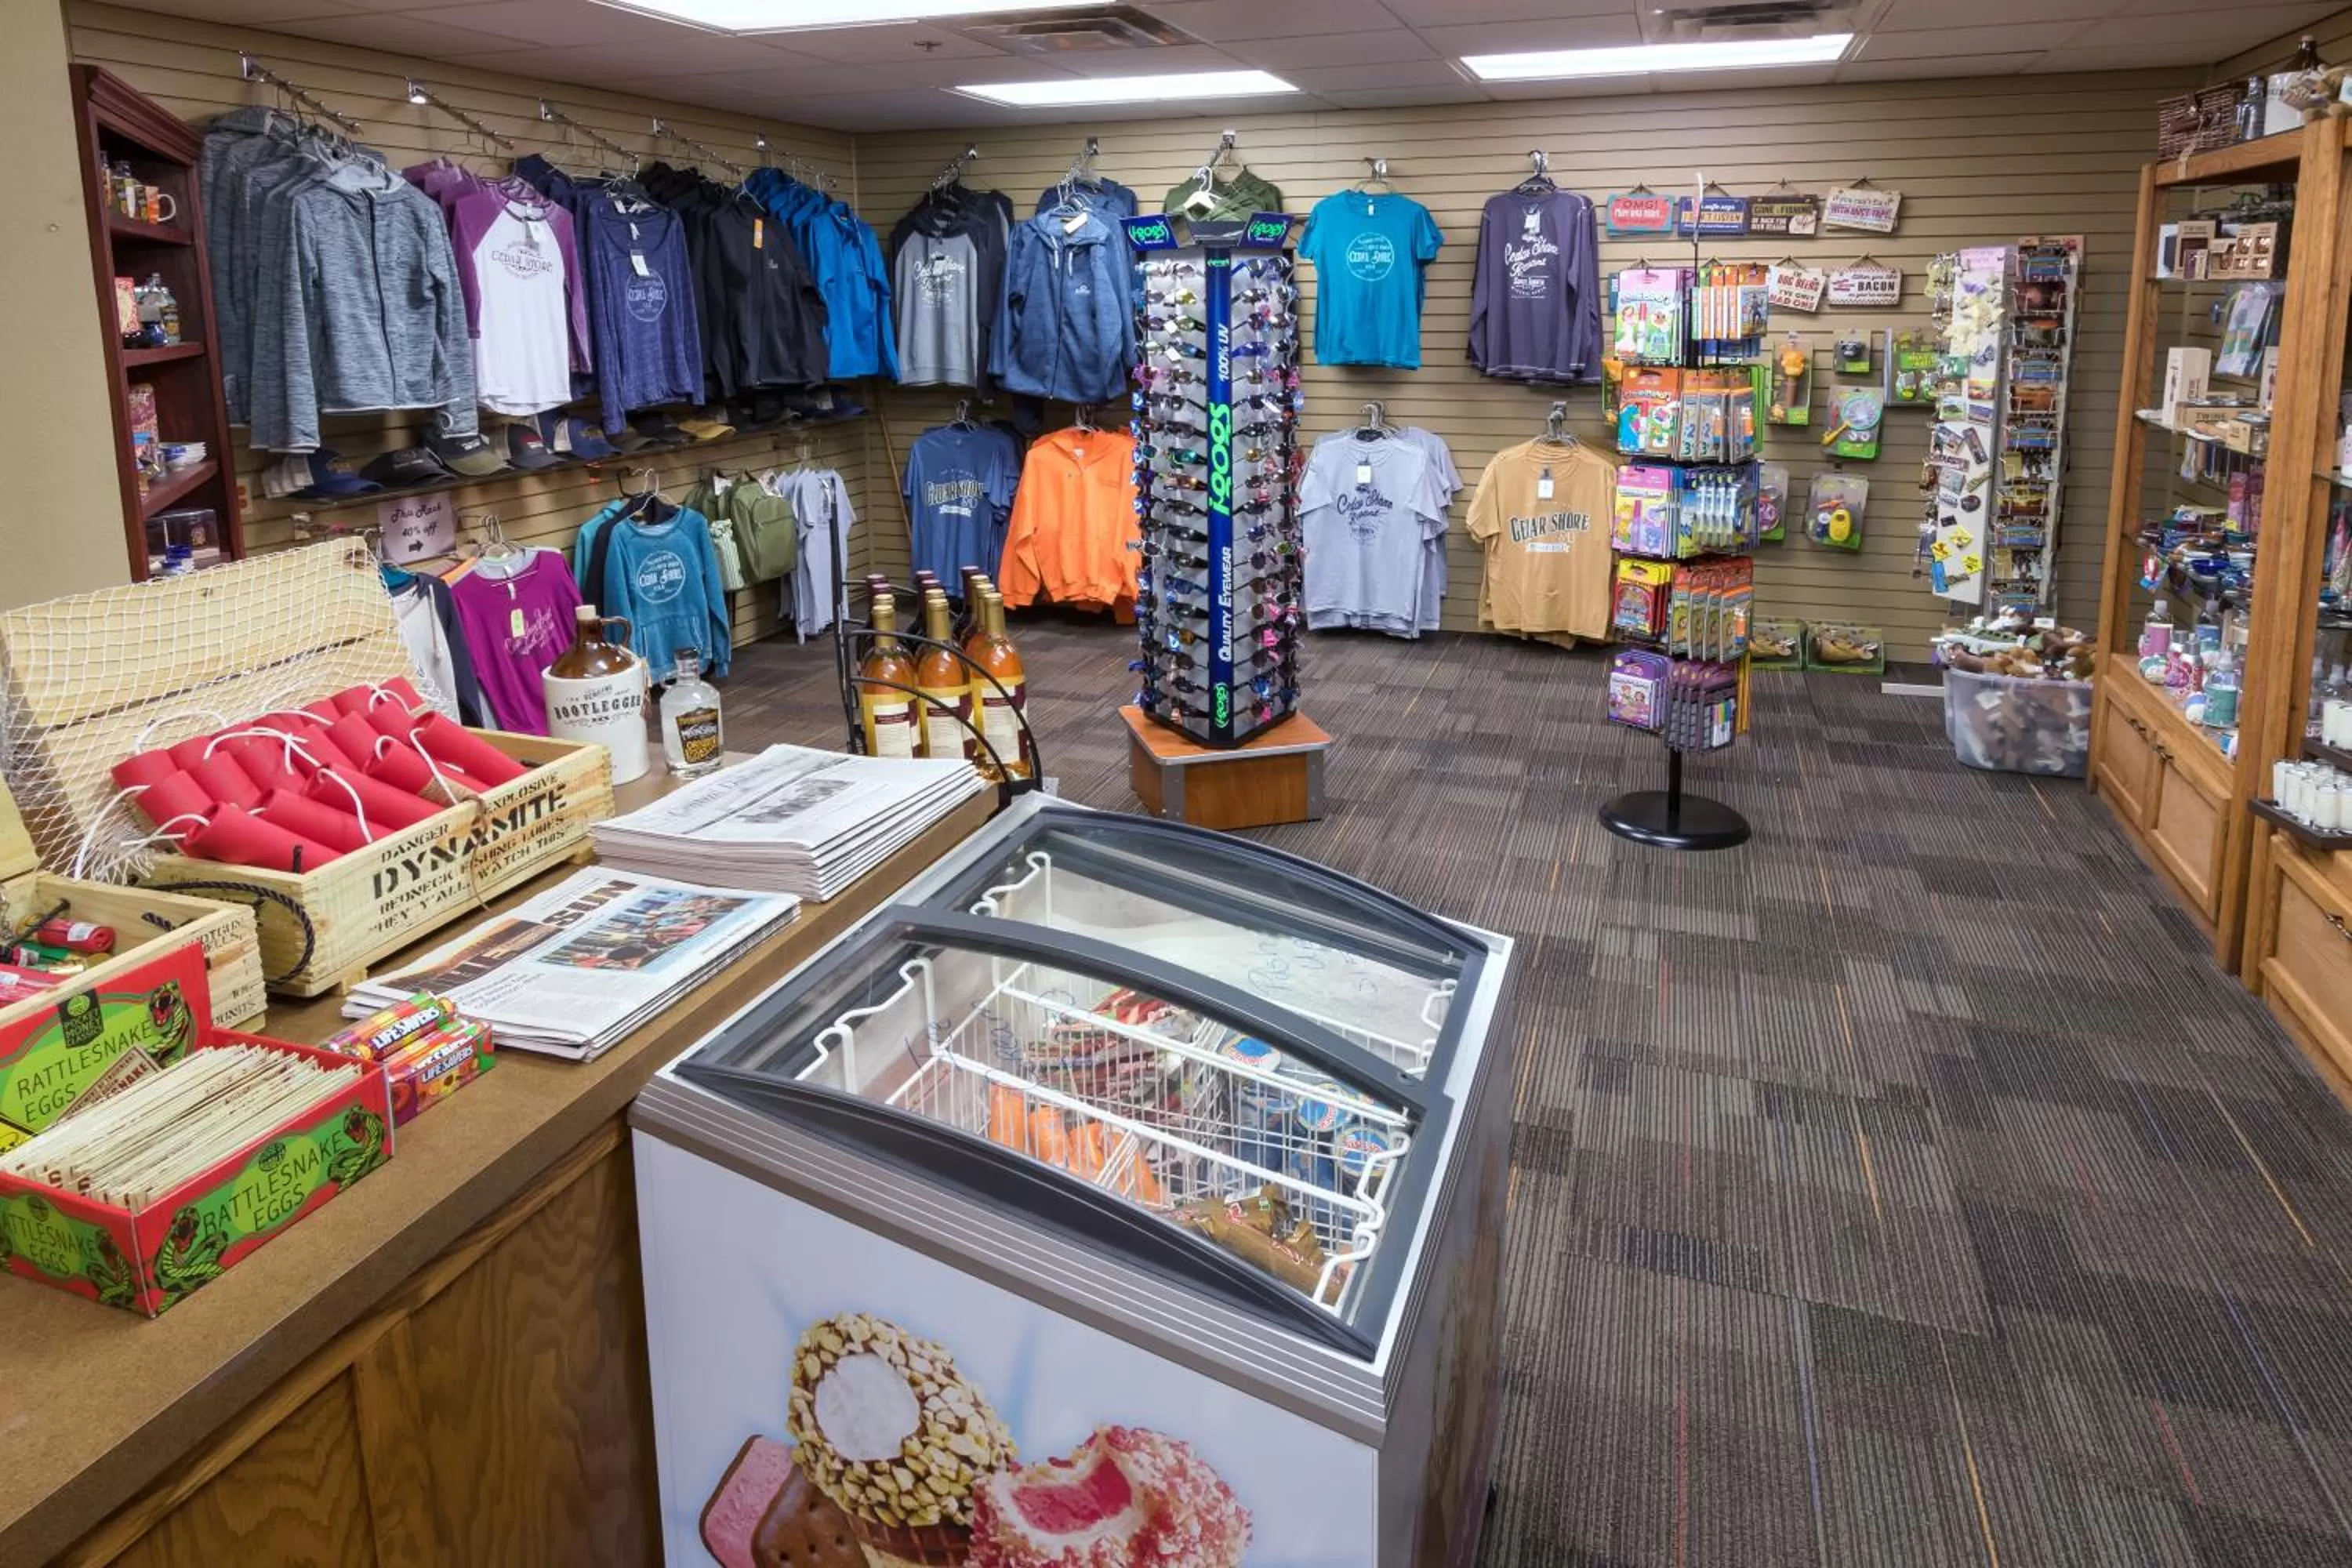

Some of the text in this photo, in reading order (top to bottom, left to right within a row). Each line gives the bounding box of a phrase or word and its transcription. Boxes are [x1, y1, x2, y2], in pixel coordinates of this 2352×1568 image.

[1857, 281, 1895, 291] BACON
[1218, 324, 1229, 382] 100% UV
[390, 502, 442, 523] This Rack
[402, 521, 437, 538] 40% off
[1551, 512, 1590, 532] SHORE
[382, 771, 559, 862] DANGER EXPLOSIVE
[373, 782, 567, 899] DYNAMITE
[477, 846, 530, 880] WATCH
[379, 870, 454, 915] REDNECK
[523, 815, 565, 843] LURES
[542, 880, 638, 927] SUN
[16, 1019, 152, 1100] RATTLESNAKE
[24, 1083, 76, 1123] EGGS
[203, 1129, 345, 1235] RATTLESNAKE
[253, 1185, 307, 1232] EGGS
